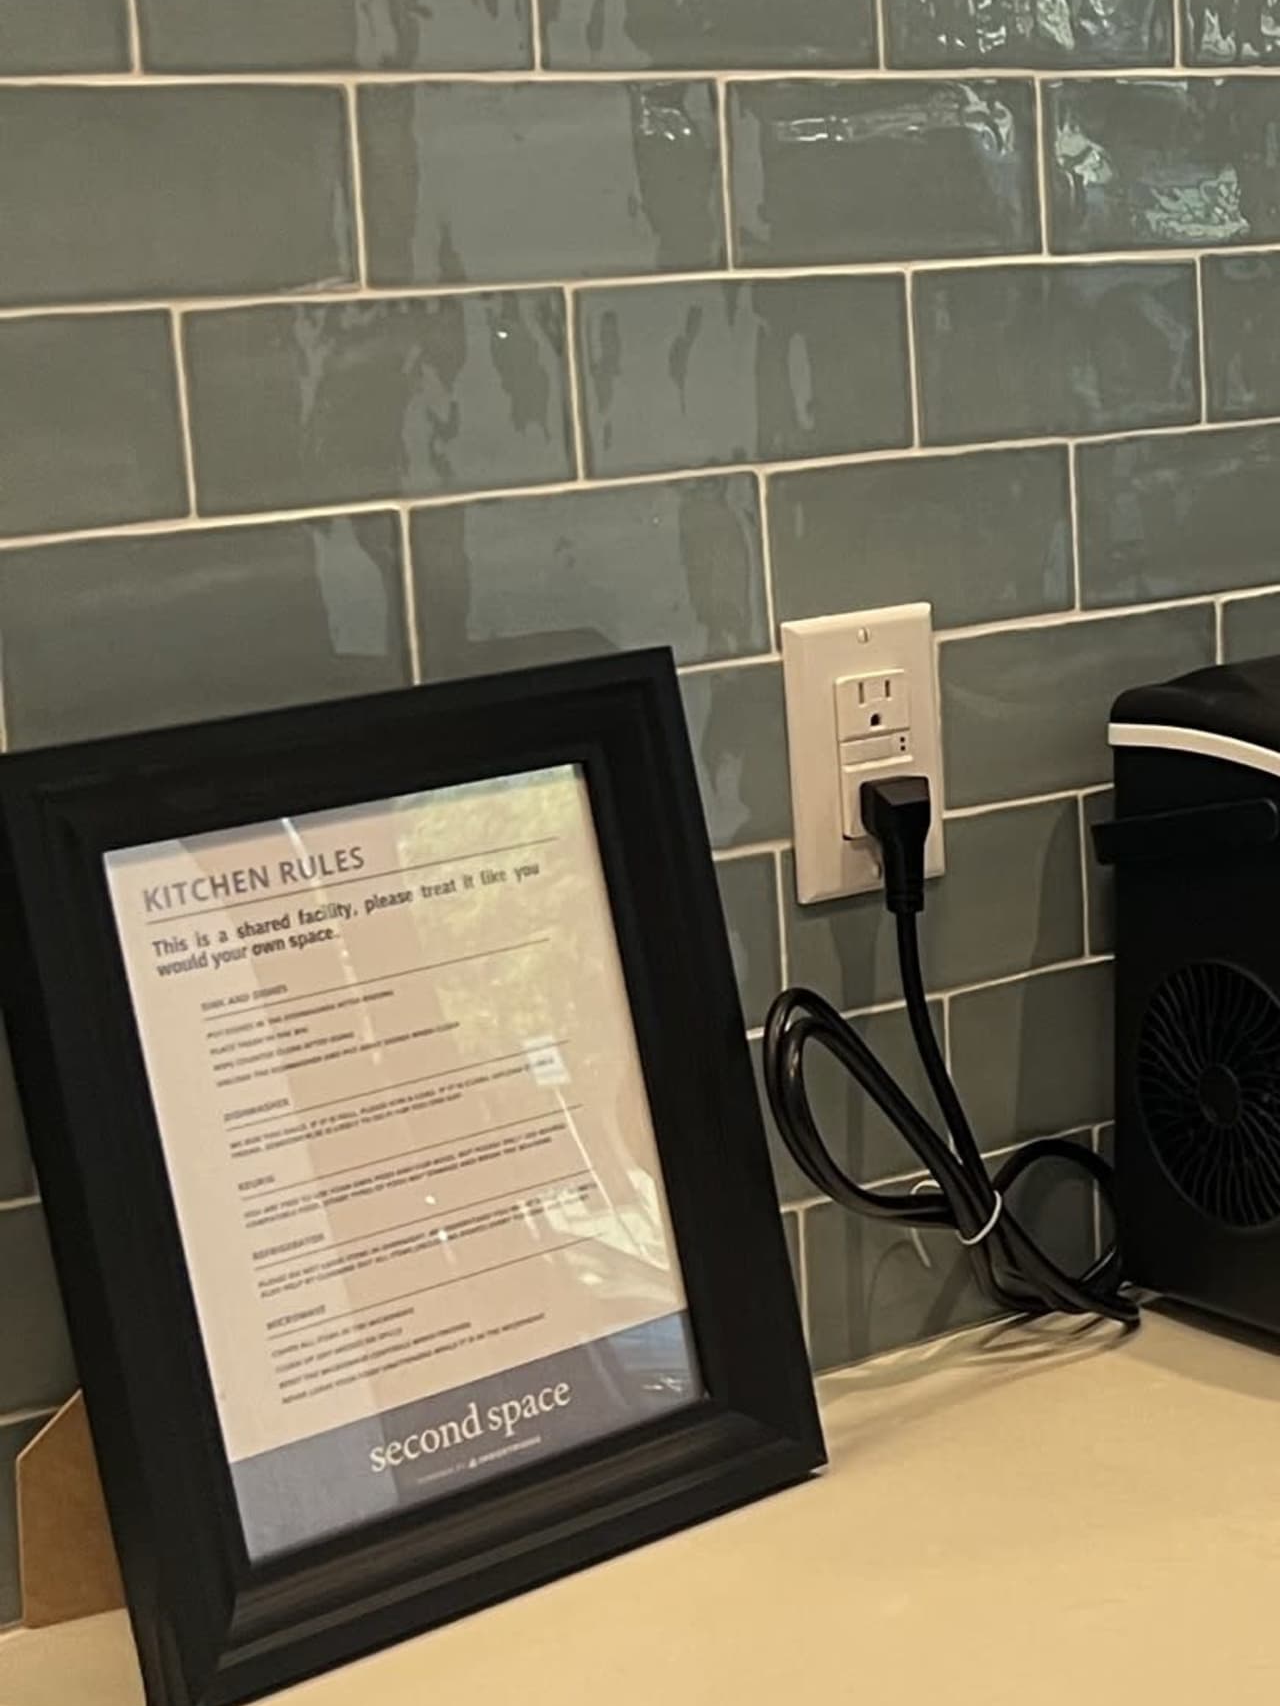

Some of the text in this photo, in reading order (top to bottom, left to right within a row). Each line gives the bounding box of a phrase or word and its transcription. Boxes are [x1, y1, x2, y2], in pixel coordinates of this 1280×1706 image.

[143, 846, 365, 912] KITCHEN RULES
[152, 863, 541, 958] This is a shared facility, please treat it like you
[157, 927, 341, 978] would your own space.
[369, 1402, 484, 1473] second
[487, 1381, 572, 1438] space
